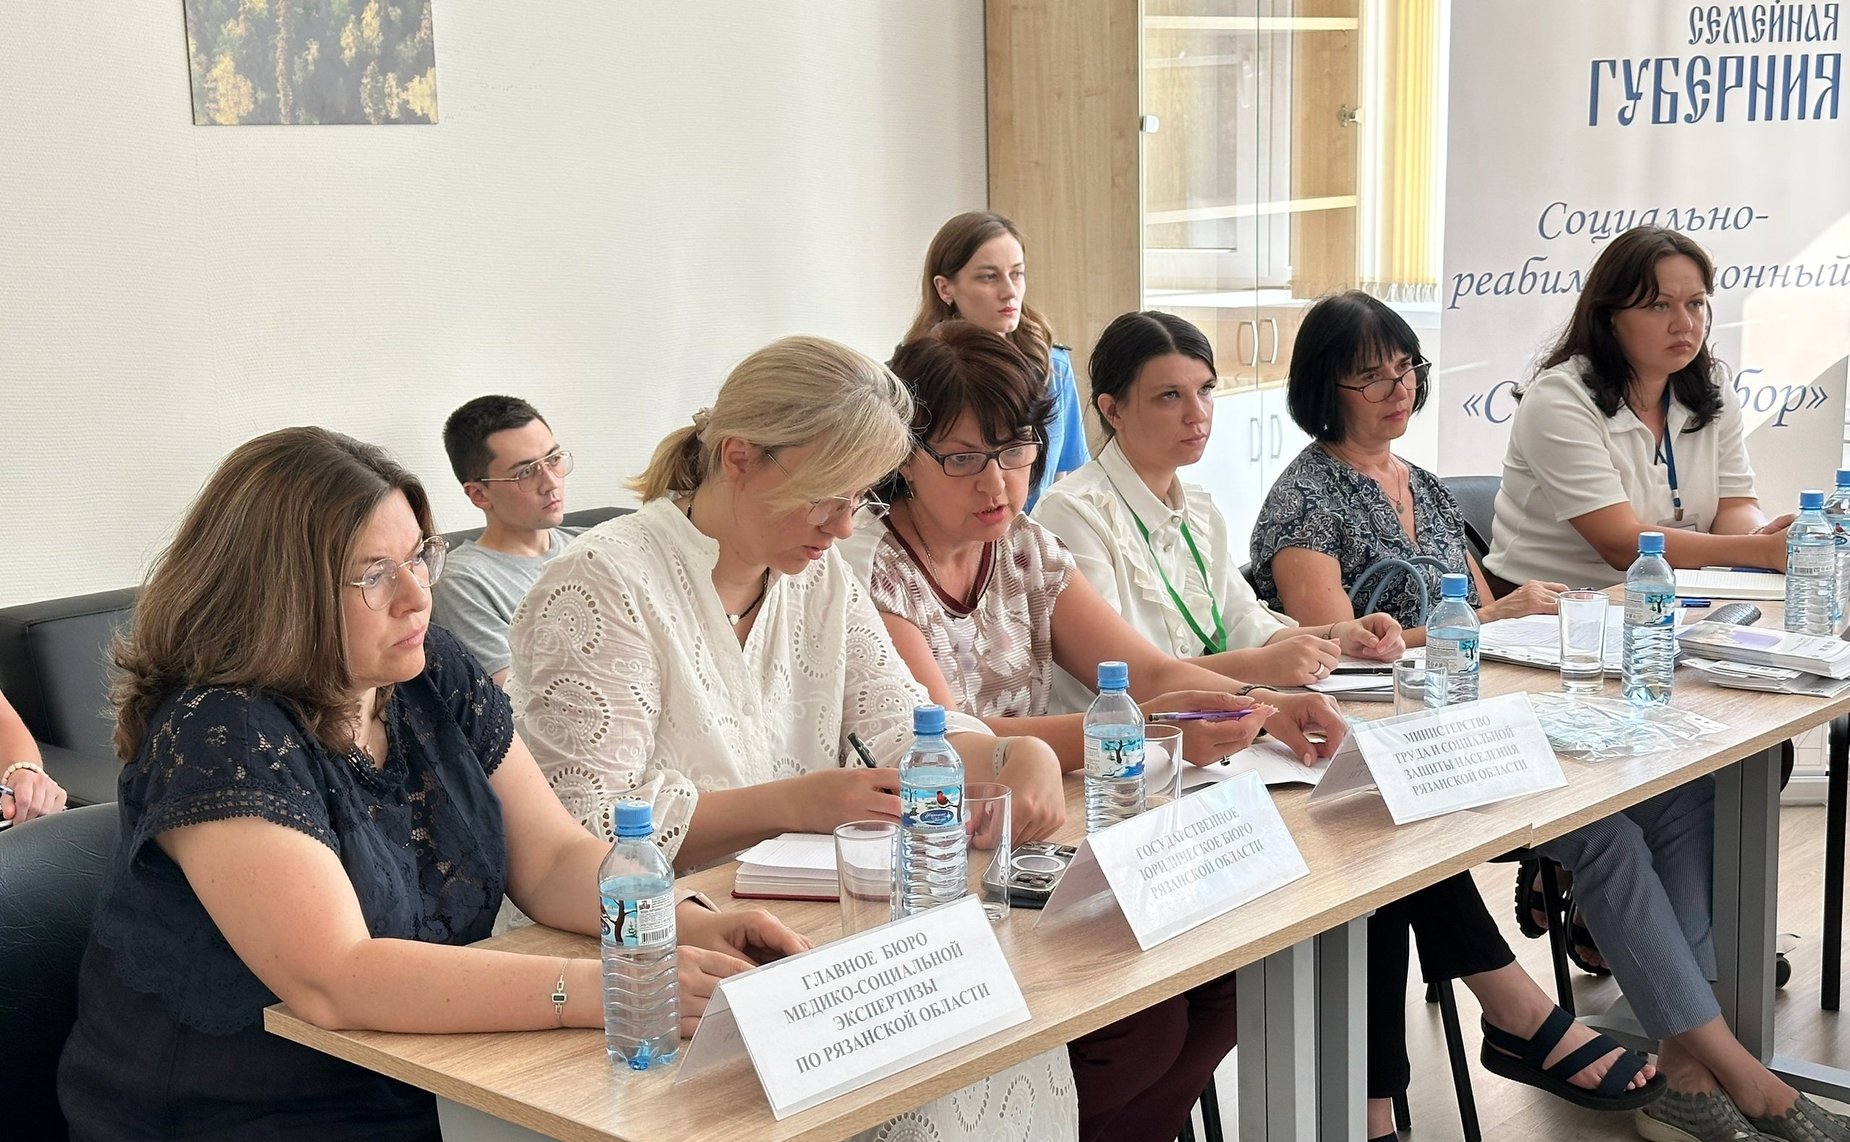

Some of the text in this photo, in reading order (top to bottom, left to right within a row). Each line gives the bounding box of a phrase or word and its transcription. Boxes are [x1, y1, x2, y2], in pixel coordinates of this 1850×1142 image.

[1688, 0, 1839, 45] СЕМЕЙНАЯ
[1588, 53, 1842, 126] ГУБЕРНИЯ
[1538, 202, 1769, 243] Социально-
[1447, 254, 1850, 310] реабилонный
[1393, 725, 1515, 764] ТРУДА И СОЦИАЛЬНОЙ
[1403, 715, 1491, 744] МИНИСТЕРСТВО
[1404, 743, 1520, 780] ЗАЩИТЫ НАСЕЛЕНИЯ
[1412, 759, 1528, 796] РЯЗАНСКОЙ ОБЛАСТИ
[1135, 806, 1240, 860] ГОСУДАРСТВЕННОЕ
[1139, 822, 1253, 881] ЮРИДИЧЕСКОЕ БЮРО
[1150, 839, 1264, 899] РЯЗАНСКОЙ ОБЛАСТИ
[783, 940, 964, 1024] МЕДИКО-СОЦИАЛЬНОЙ
[801, 932, 928, 991] ГЛАВНОЕ БЮРО
[795, 982, 991, 1074] ПО РЯЗАНСКОЙ ОБЛАСТИ
[832, 978, 938, 1031] ЭКСПЕРТИЗЫ
